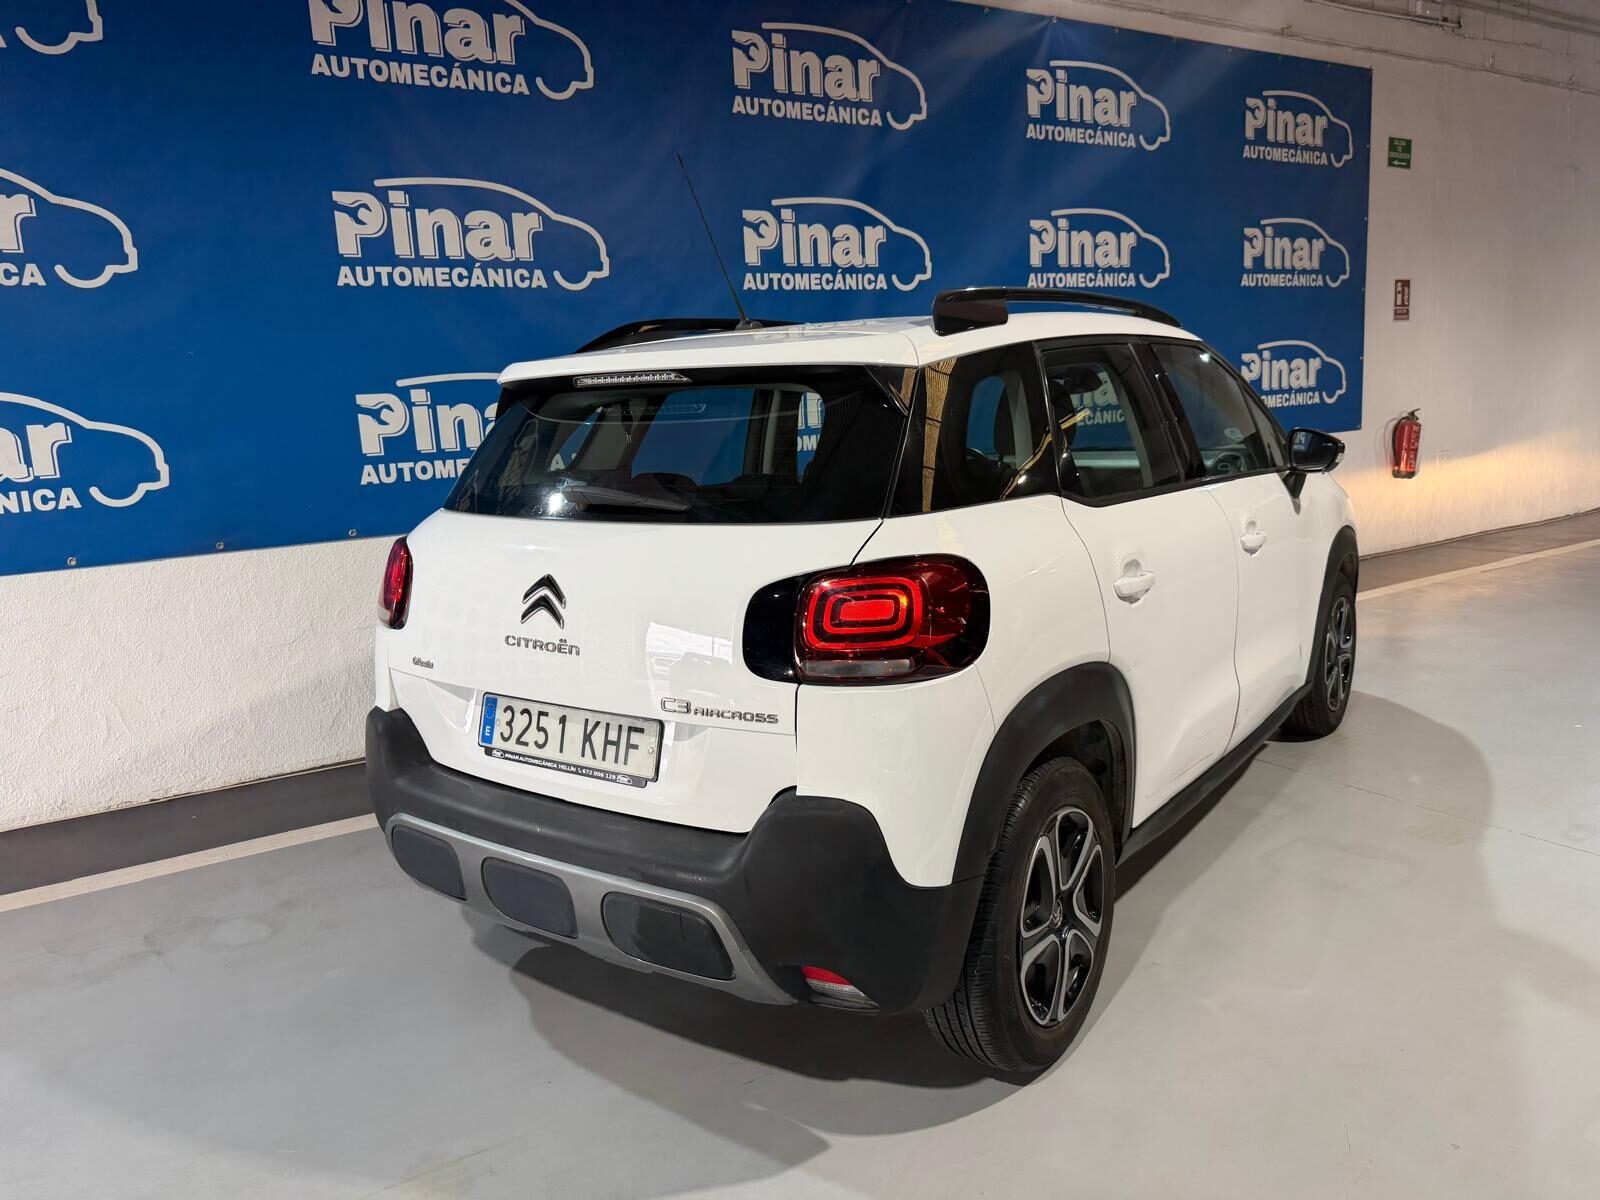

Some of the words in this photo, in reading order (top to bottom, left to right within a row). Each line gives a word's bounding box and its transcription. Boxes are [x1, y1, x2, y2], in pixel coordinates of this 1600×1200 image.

[308, 0, 525, 65] Pinar
[311, 53, 530, 95] AUTOMECÁNICA
[732, 30, 881, 102] Pinar
[732, 95, 883, 126] AUTOMECÁNICA
[1026, 68, 1137, 127] Pinar
[1026, 123, 1136, 148] AUTOMECÁNICA
[1245, 97, 1328, 147] Pinar
[1242, 144, 1328, 166] AUTOMECÁNICA
[332, 190, 543, 262] Pinar
[742, 208, 887, 268] Pinar
[1029, 218, 1137, 268] Pinar
[1243, 226, 1325, 270] Pinar
[337, 263, 548, 288] AUTOMECÁNICA
[743, 269, 888, 290] AUTOMECÁNICA
[1027, 269, 1136, 288] AUTOMECÁNICA
[1240, 271, 1324, 287] AUTOMECÁNICA
[1241, 350, 1322, 391] Pinar
[504, 635, 581, 656] CITROËN
[661, 697, 692, 715] C3
[693, 706, 779, 724] AIRCROSS
[500, 705, 567, 754] 3251
[580, 718, 645, 766] KHF
